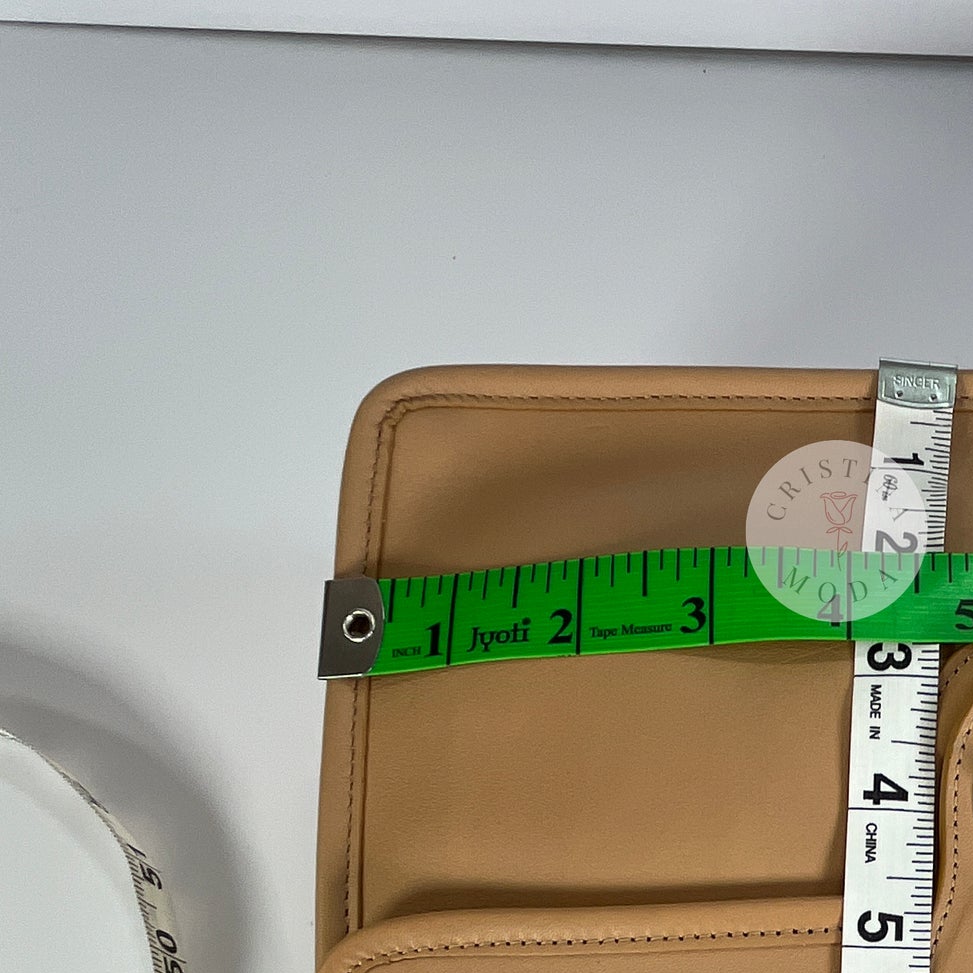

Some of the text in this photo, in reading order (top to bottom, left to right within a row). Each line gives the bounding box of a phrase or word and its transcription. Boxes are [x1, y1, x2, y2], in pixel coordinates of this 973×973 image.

[893, 374, 941, 390] SINGER
[883, 453, 924, 466] 1
[547, 609, 573, 644] 2
[680, 597, 706, 634] 3
[817, 594, 844, 627] 4
[424, 622, 443, 657] 1
[467, 617, 531, 652] Jyoti
[590, 624, 672, 640] Tape Measure
[392, 646, 421, 658] INCH
[867, 643, 912, 672] 3
[869, 684, 882, 740] MADE IN
[863, 773, 909, 805] 4
[865, 822, 878, 864] CHINA
[857, 910, 904, 943] 5
